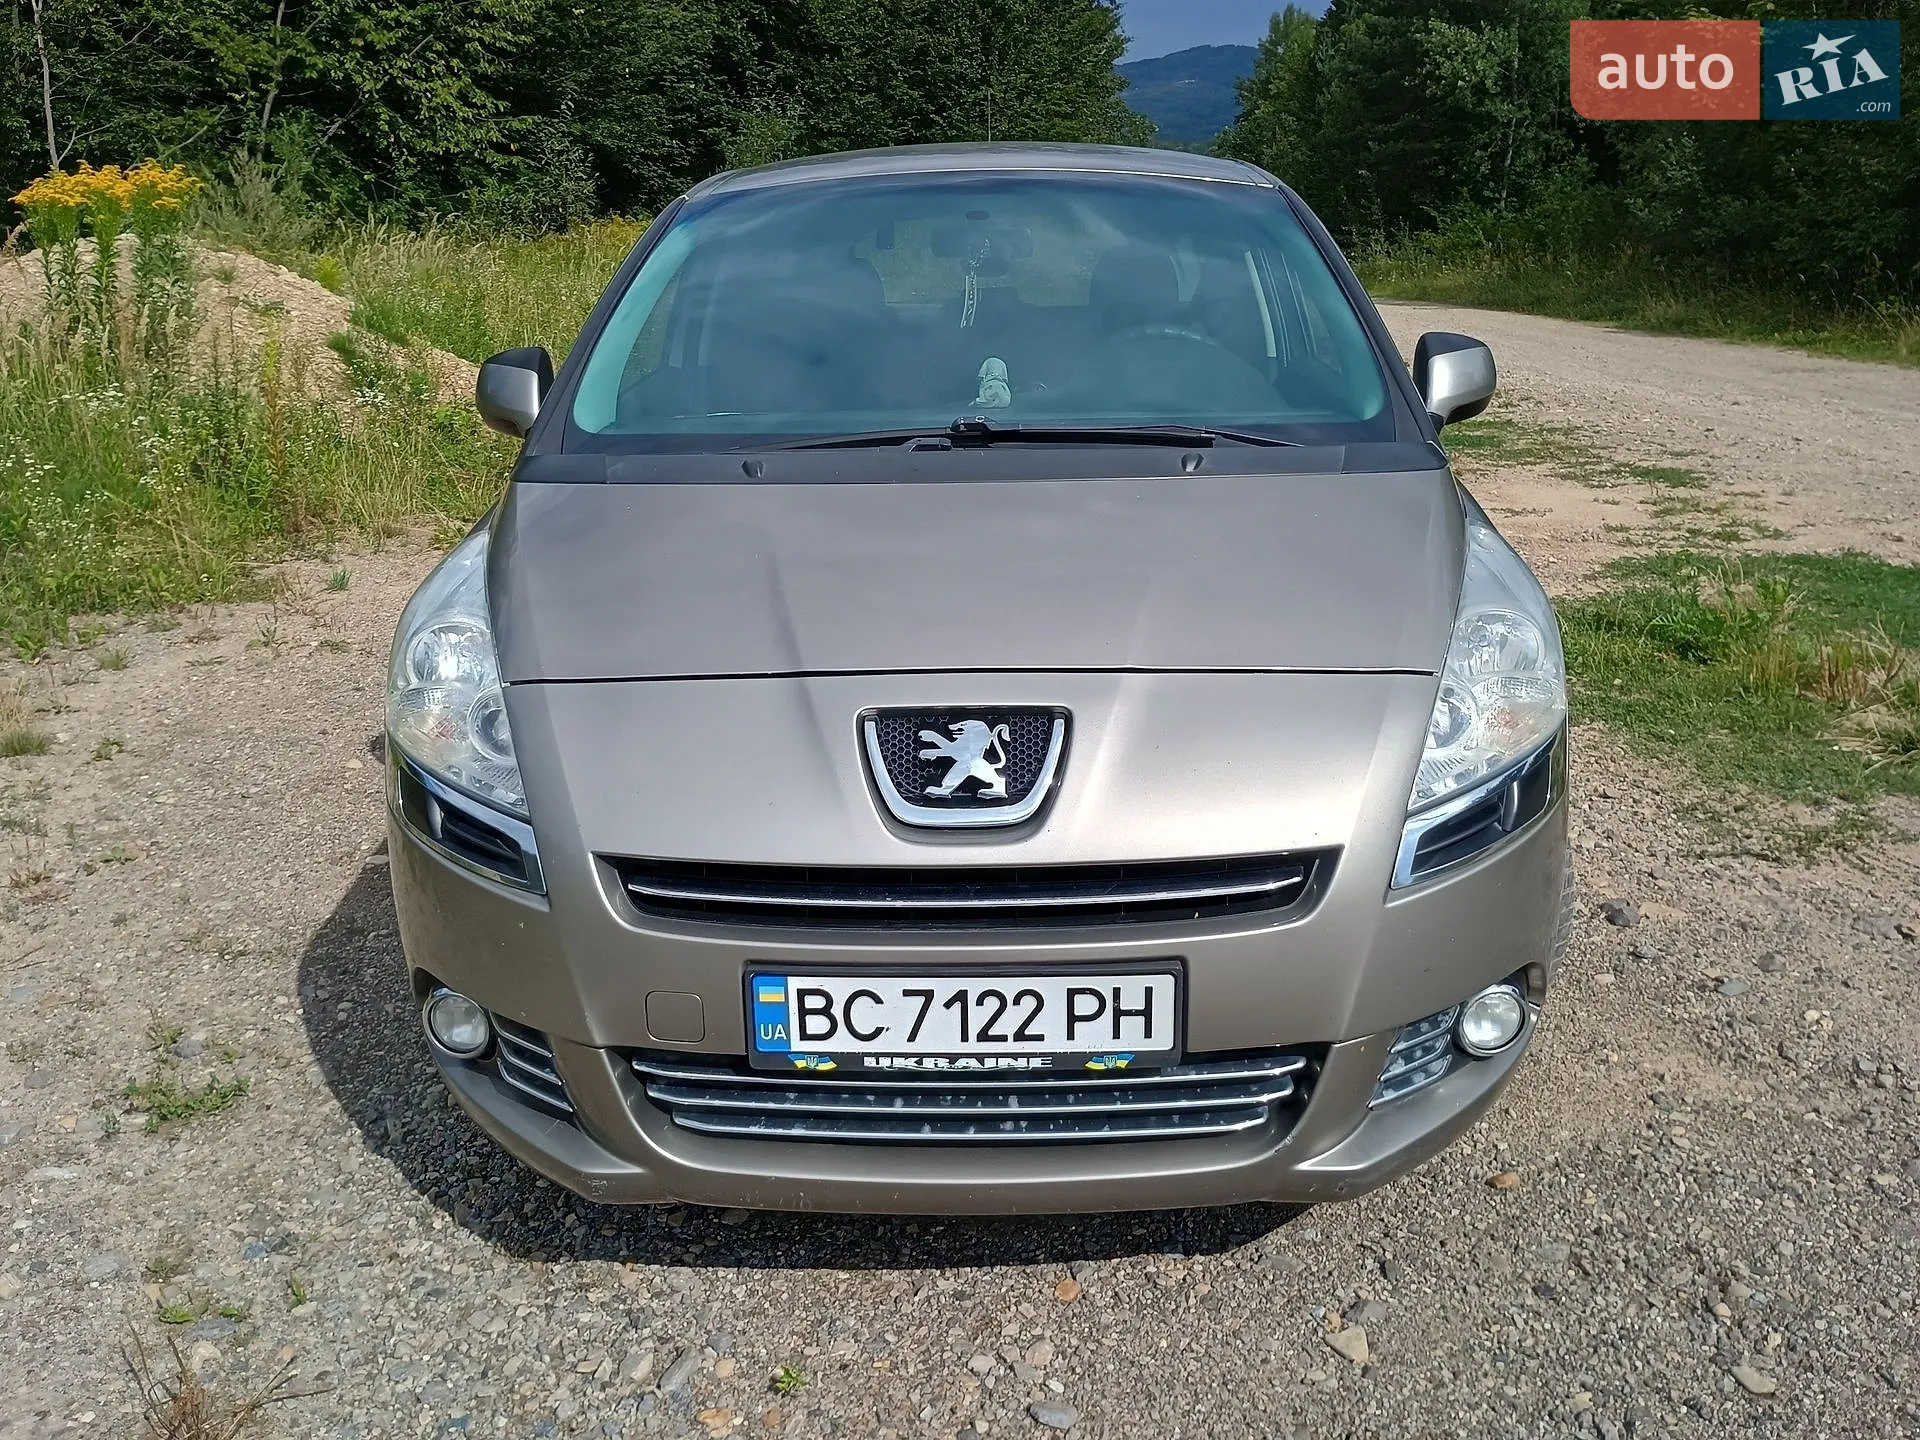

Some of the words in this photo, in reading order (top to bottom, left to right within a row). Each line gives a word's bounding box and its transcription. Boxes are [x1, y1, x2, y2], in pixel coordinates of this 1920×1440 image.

[797, 988, 887, 1042] BC
[902, 988, 1045, 1043] 7122
[1066, 986, 1153, 1041] PH
[760, 1023, 787, 1040] UA
[863, 1056, 1053, 1069] UKRAINE
